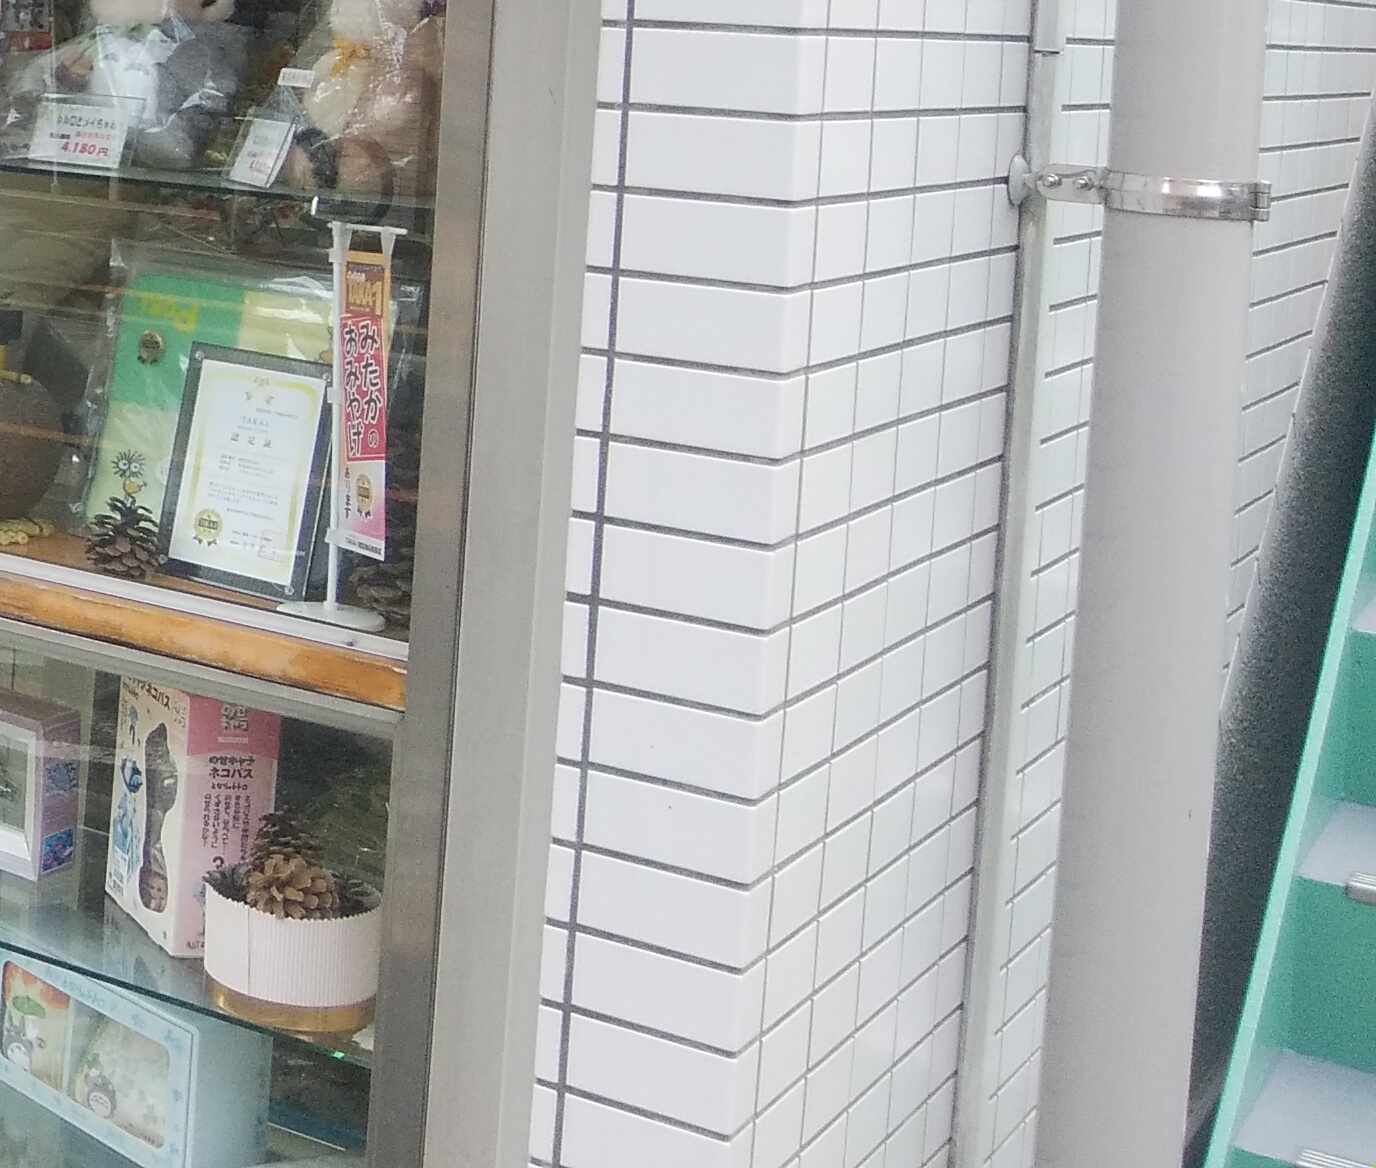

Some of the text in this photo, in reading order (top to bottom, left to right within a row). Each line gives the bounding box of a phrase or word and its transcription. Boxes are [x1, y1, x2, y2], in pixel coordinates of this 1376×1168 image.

[344, 323, 364, 457] おみやげ
[359, 321, 383, 448] みたかの
[209, 767, 255, 779] ネコバス
